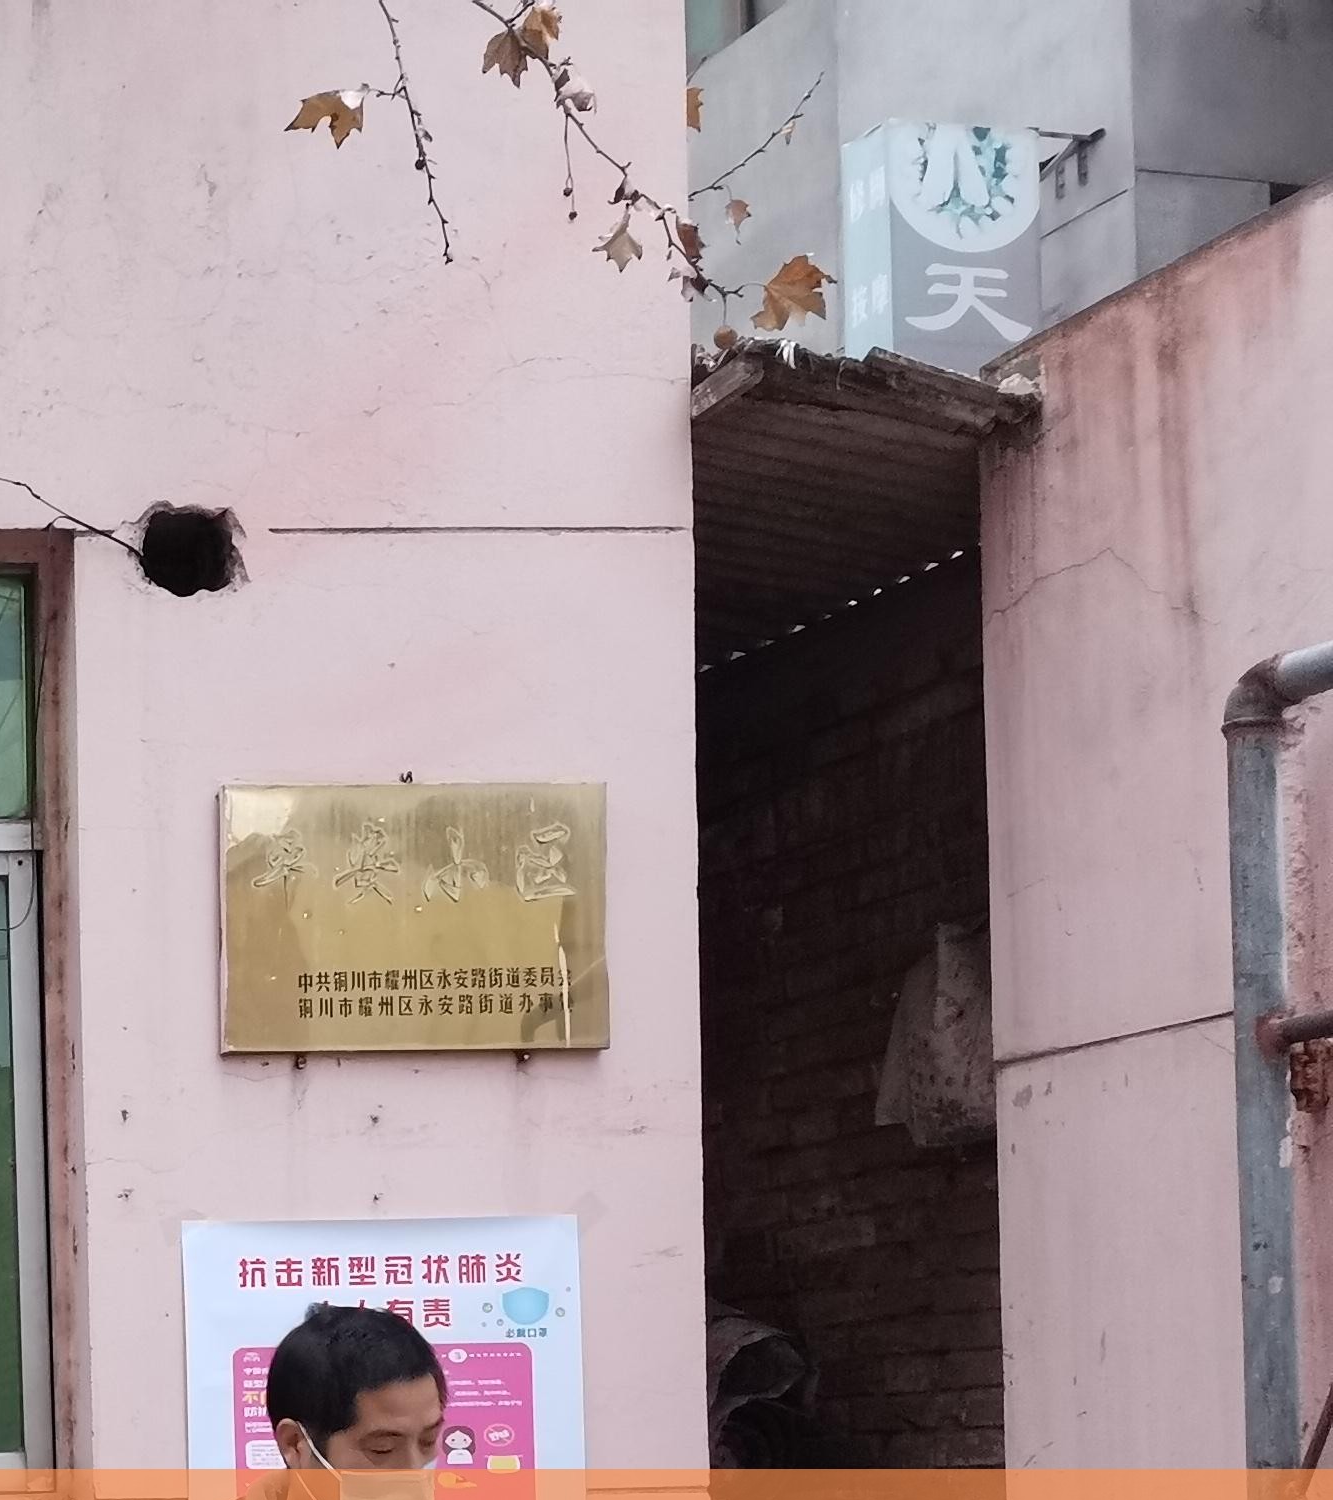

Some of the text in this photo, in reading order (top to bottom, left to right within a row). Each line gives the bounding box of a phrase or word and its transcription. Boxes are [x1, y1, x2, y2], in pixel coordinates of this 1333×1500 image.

[904, 262, 1033, 343] 天
[237, 1252, 525, 1288] 抗击新型冠状肺炎
